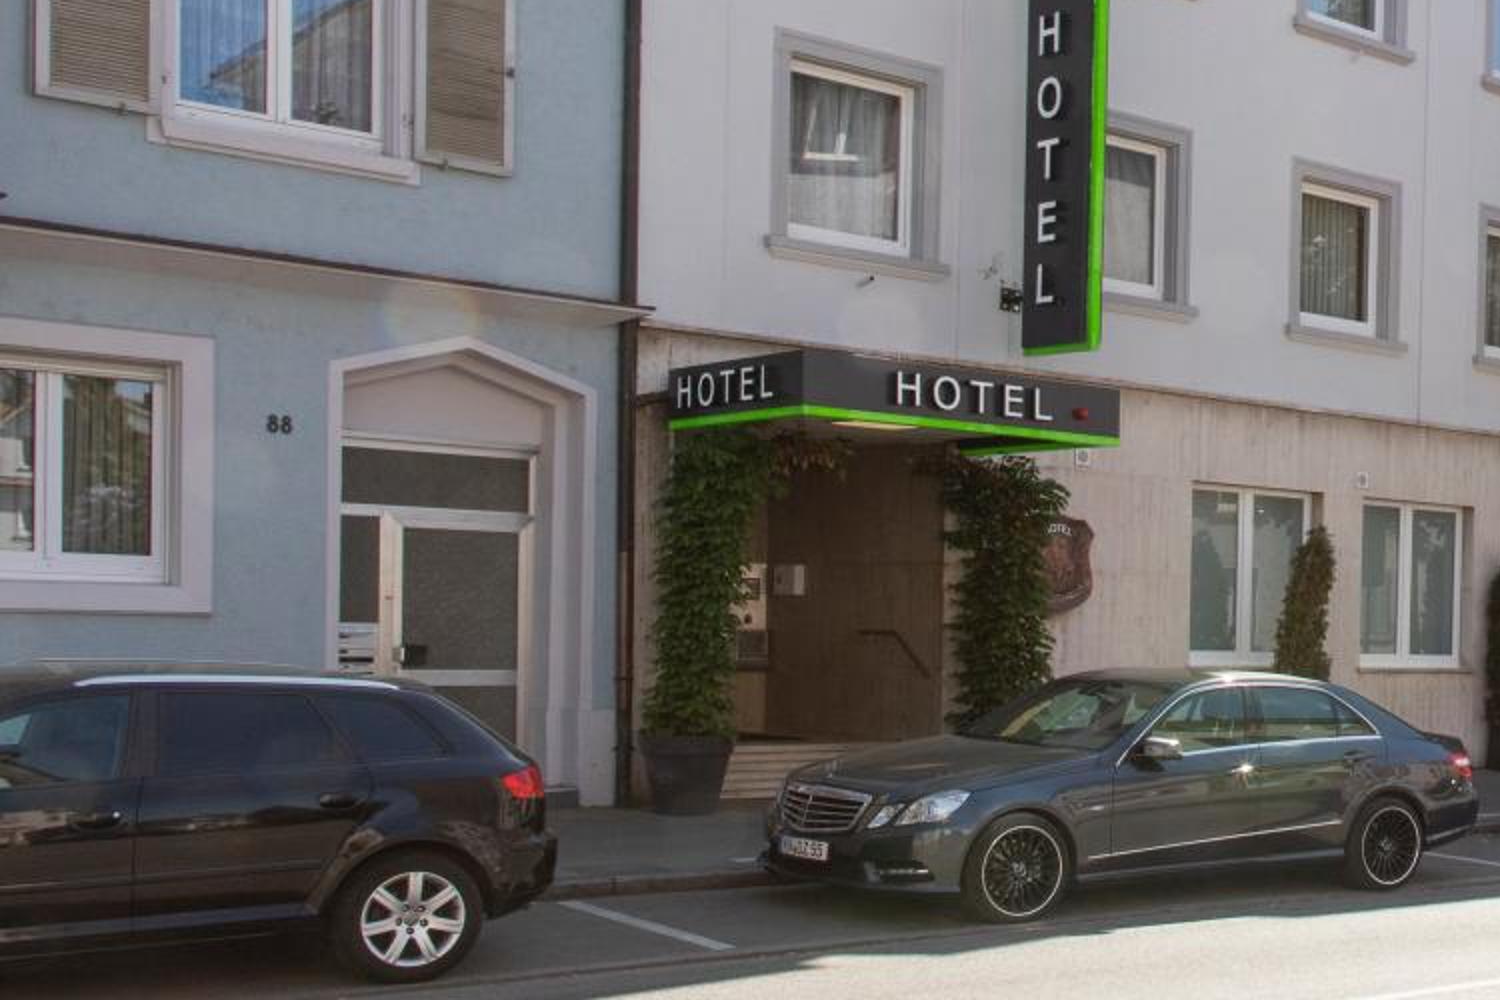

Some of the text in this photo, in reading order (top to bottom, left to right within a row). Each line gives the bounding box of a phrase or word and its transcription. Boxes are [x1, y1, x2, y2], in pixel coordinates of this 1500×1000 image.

[1036, 11, 1062, 305] HOTEL
[677, 364, 774, 409] HOTEL
[897, 370, 1054, 421] HOTEL
[267, 414, 292, 434] 88
